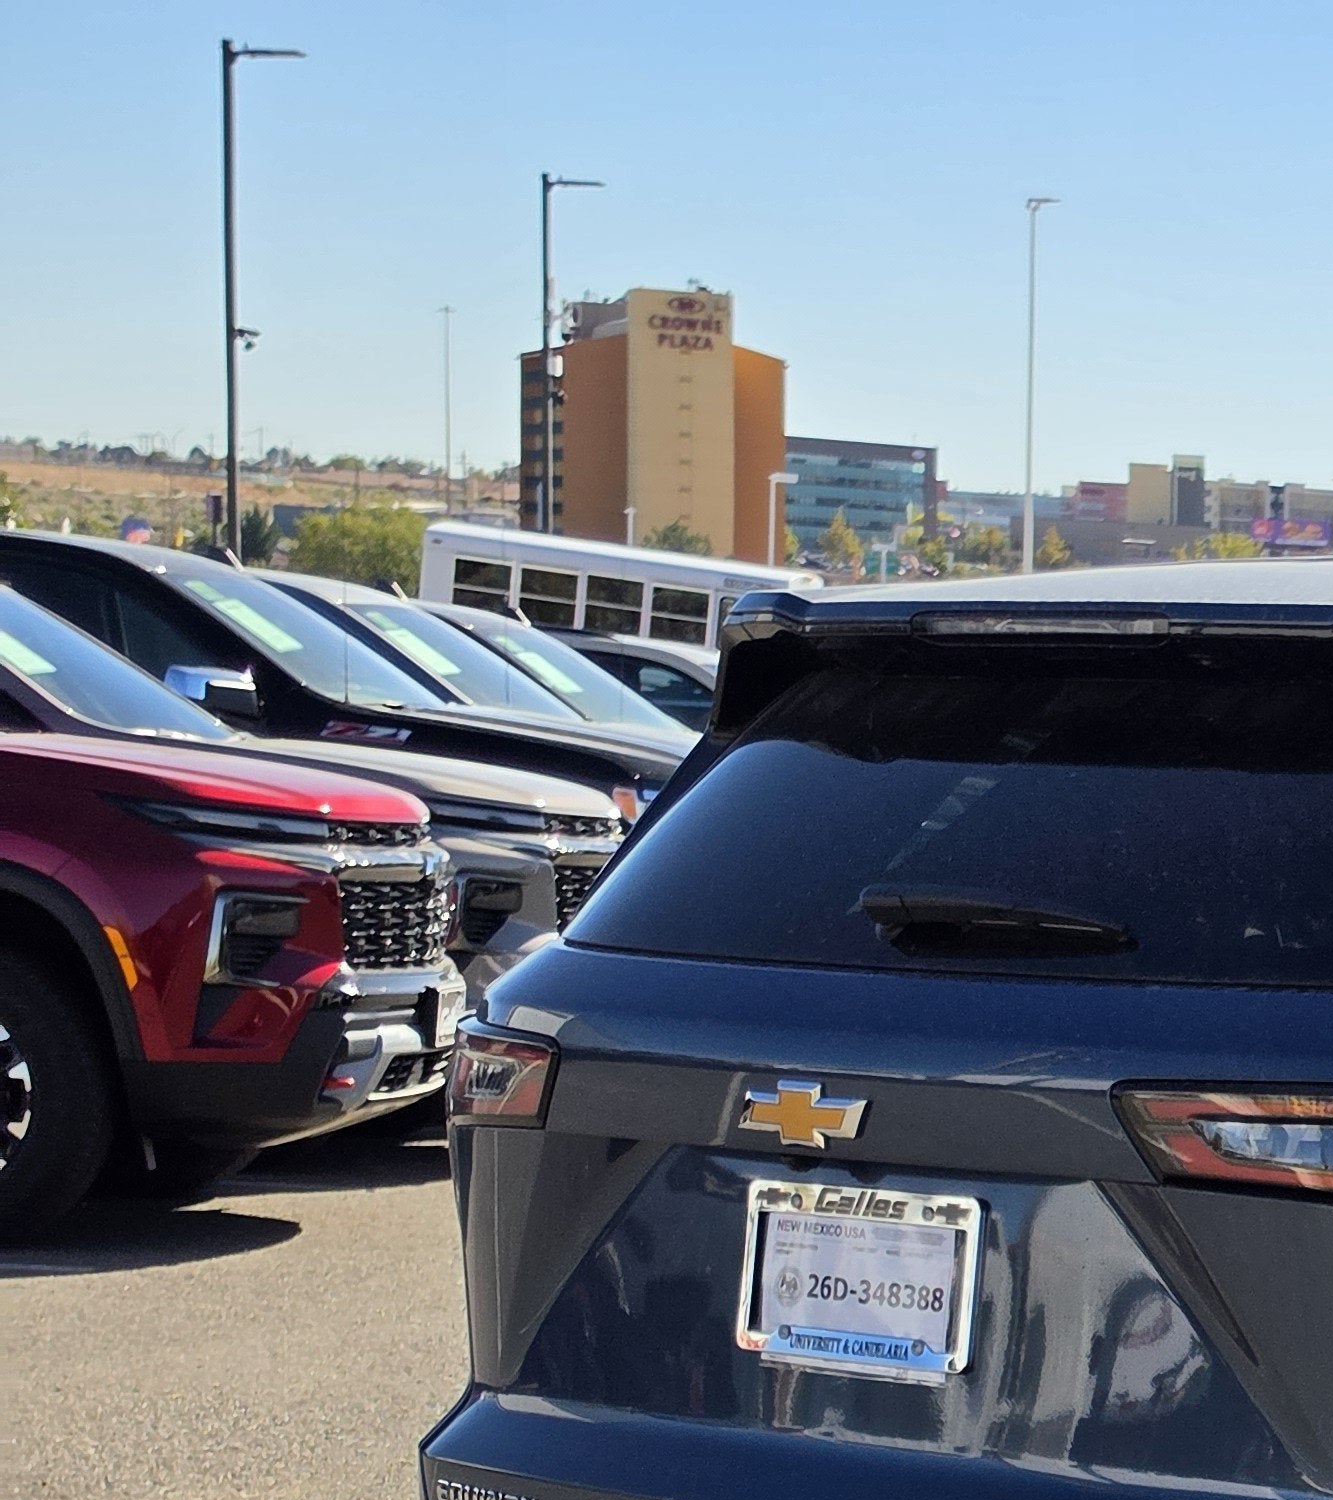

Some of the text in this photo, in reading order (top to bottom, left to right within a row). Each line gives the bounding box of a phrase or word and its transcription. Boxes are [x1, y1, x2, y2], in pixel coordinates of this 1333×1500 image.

[647, 314, 723, 335] CROWNE
[657, 333, 714, 352] PLAZA
[814, 1187, 909, 1220] Galles
[776, 1219, 801, 1233] NEW
[804, 1222, 843, 1237] MEXICO
[845, 1226, 866, 1240] USA
[807, 1273, 944, 1313] 26D-348388
[789, 1333, 909, 1362] UNIVERSITY & CANDELARIA
